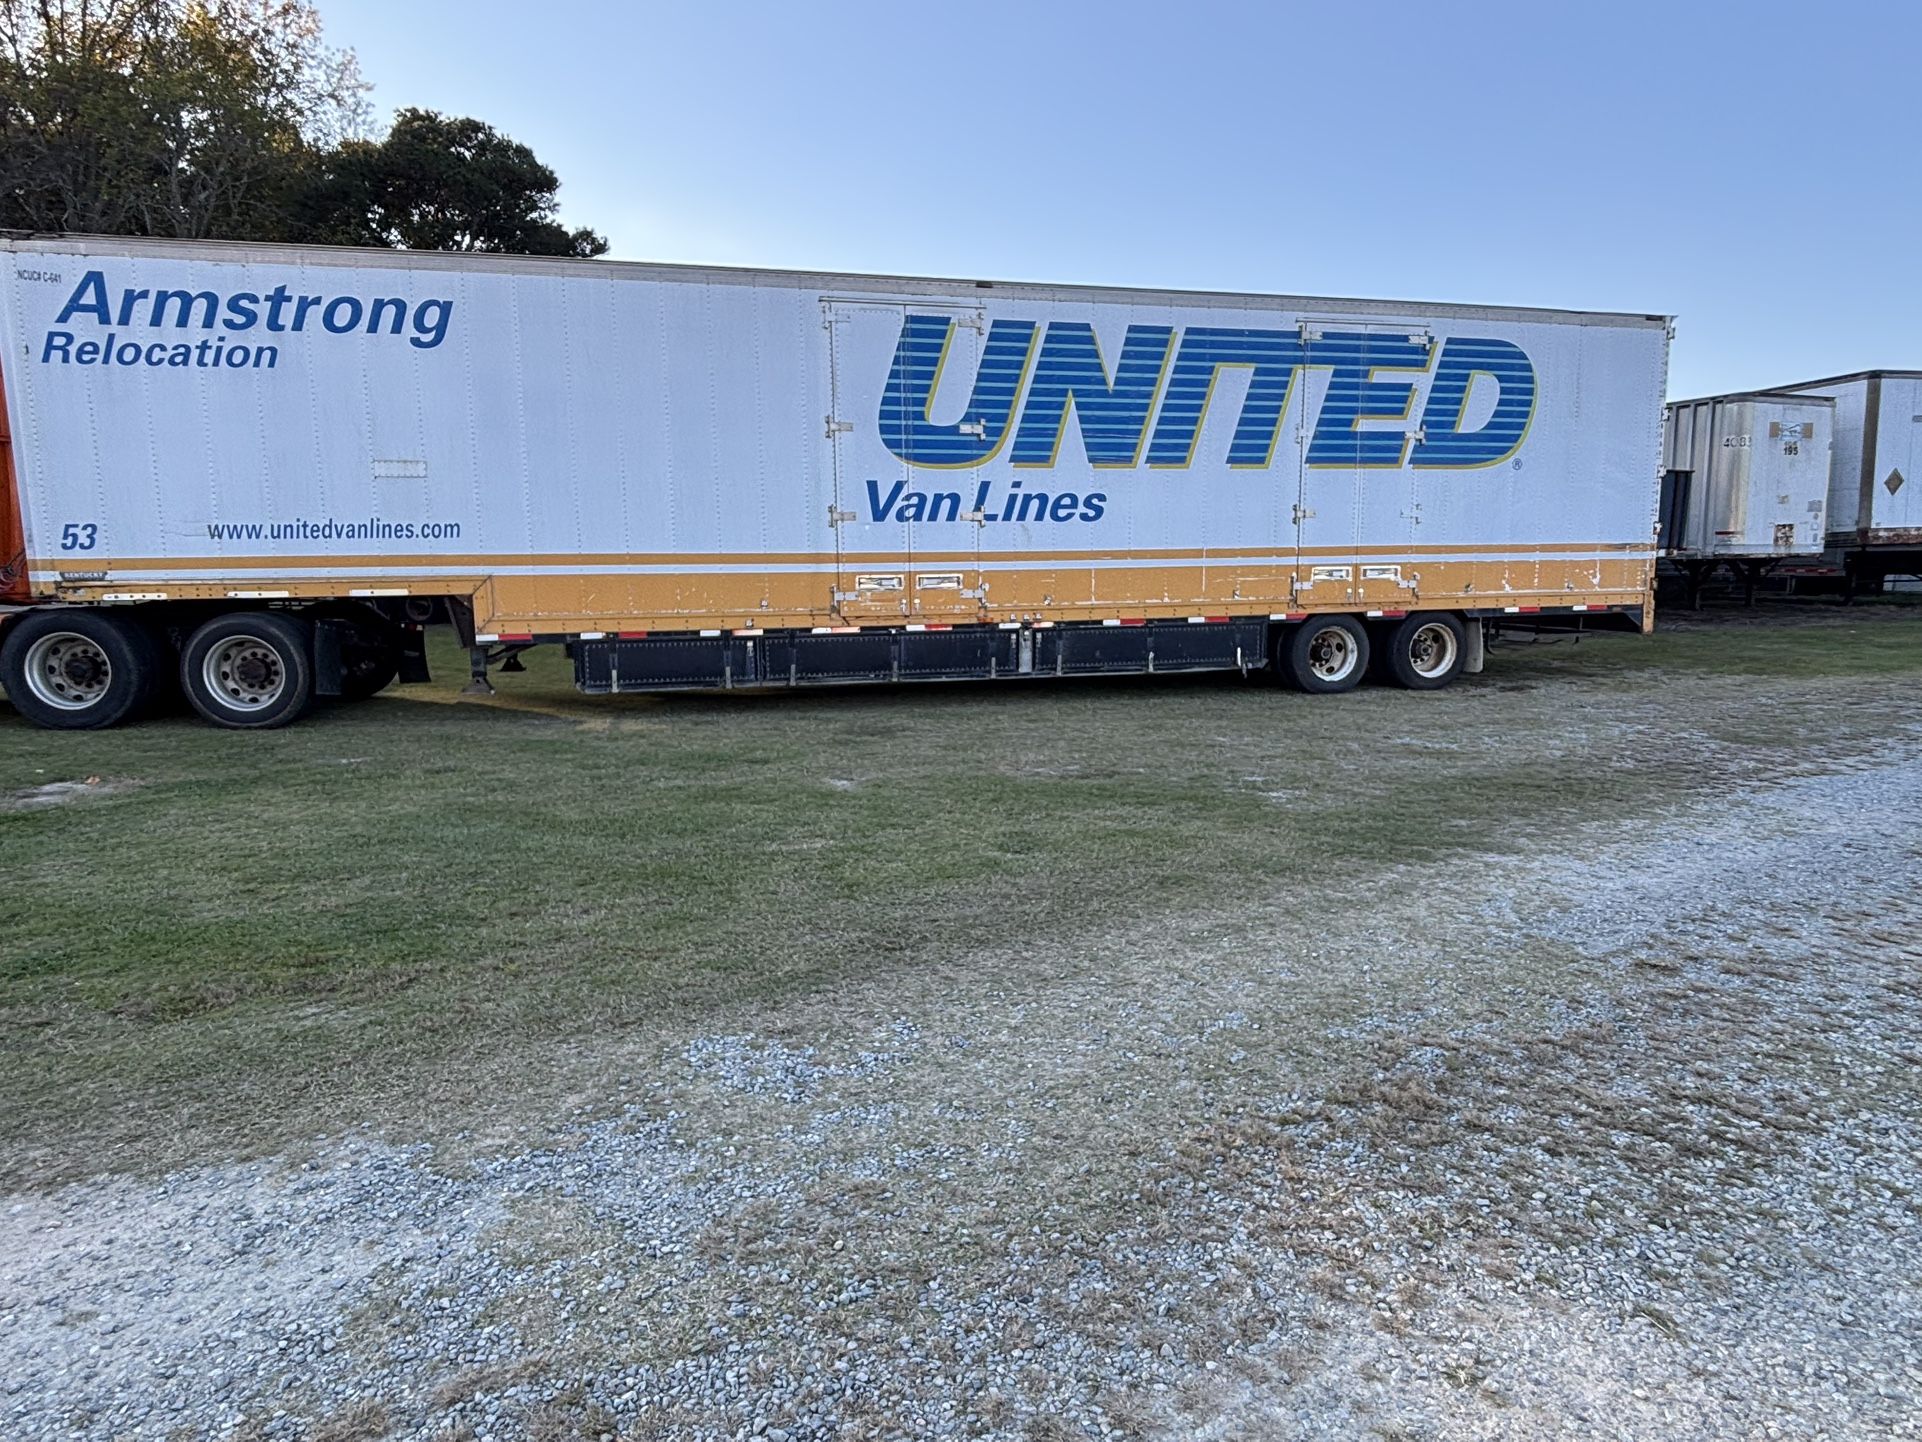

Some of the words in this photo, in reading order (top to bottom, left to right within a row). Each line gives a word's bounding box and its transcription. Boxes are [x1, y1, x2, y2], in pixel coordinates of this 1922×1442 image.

[55, 270, 454, 348] Armstrong
[41, 331, 279, 368] Relocation
[878, 314, 1537, 469] UNITED
[866, 479, 961, 523] Van
[972, 480, 1107, 523] Lines
[60, 523, 98, 550] 53
[207, 517, 461, 540] www.unitedvanlines.com
